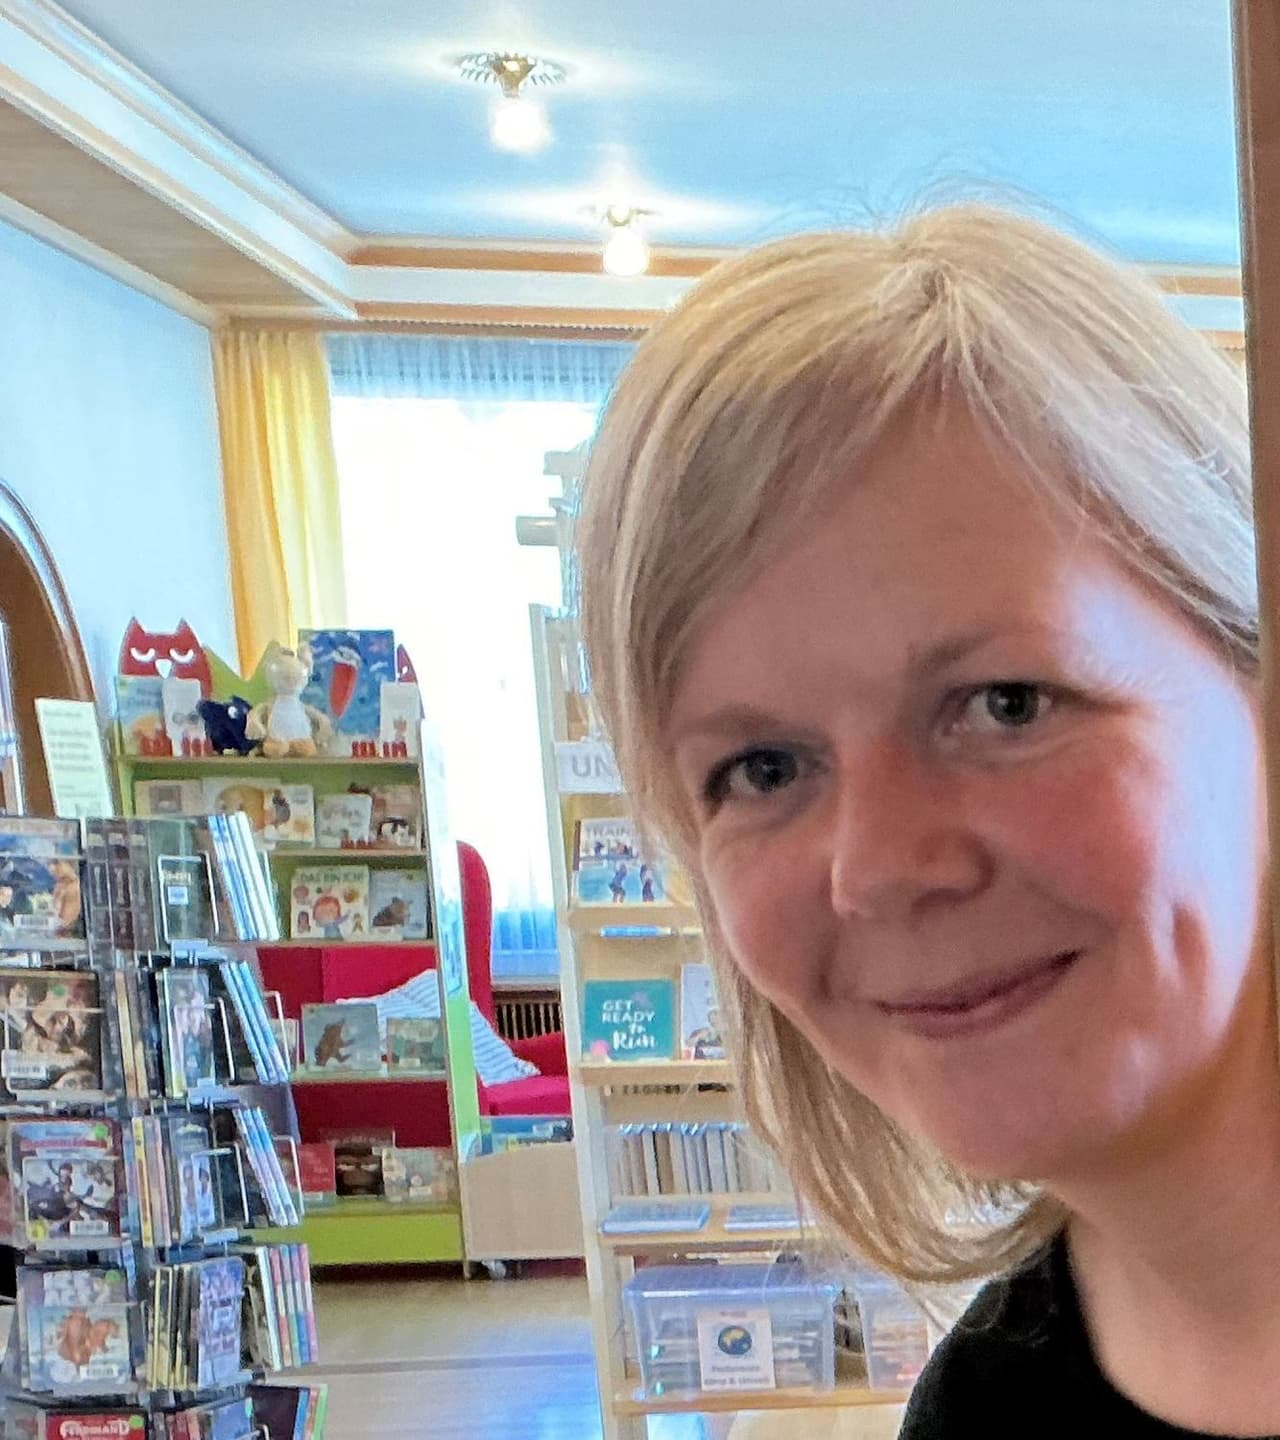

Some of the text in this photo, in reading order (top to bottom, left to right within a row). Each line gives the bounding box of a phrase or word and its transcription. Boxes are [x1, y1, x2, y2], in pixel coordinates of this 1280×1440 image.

[602, 1000, 632, 1011] GET
[601, 1011, 656, 1023] READY
[612, 1029, 656, 1051] Run
